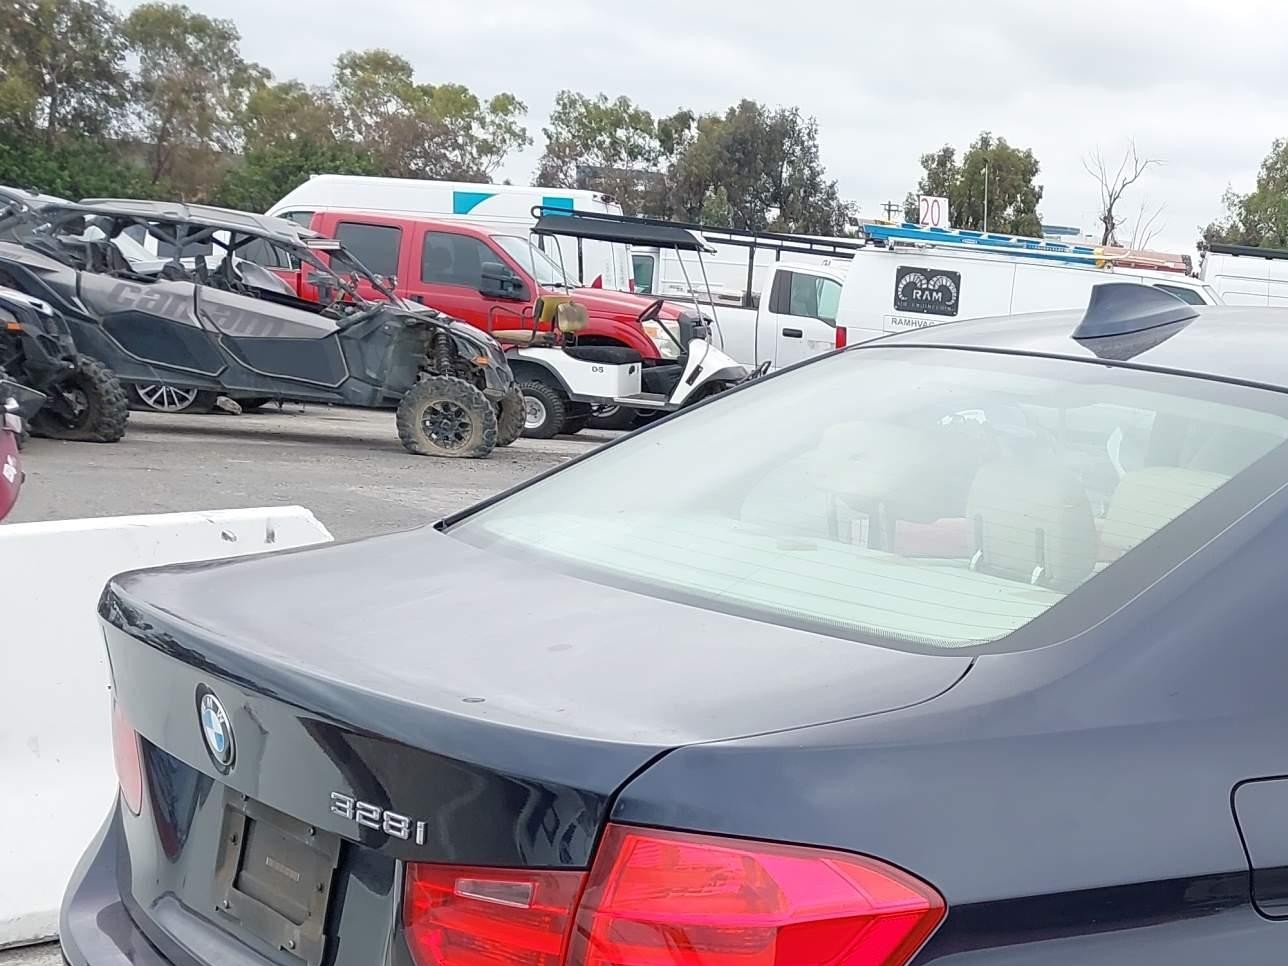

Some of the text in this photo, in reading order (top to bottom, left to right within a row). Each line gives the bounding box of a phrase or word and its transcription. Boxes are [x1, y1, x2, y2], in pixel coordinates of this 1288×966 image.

[920, 198, 941, 227] 20
[912, 289, 942, 302] RAM
[330, 791, 428, 846] 328i
